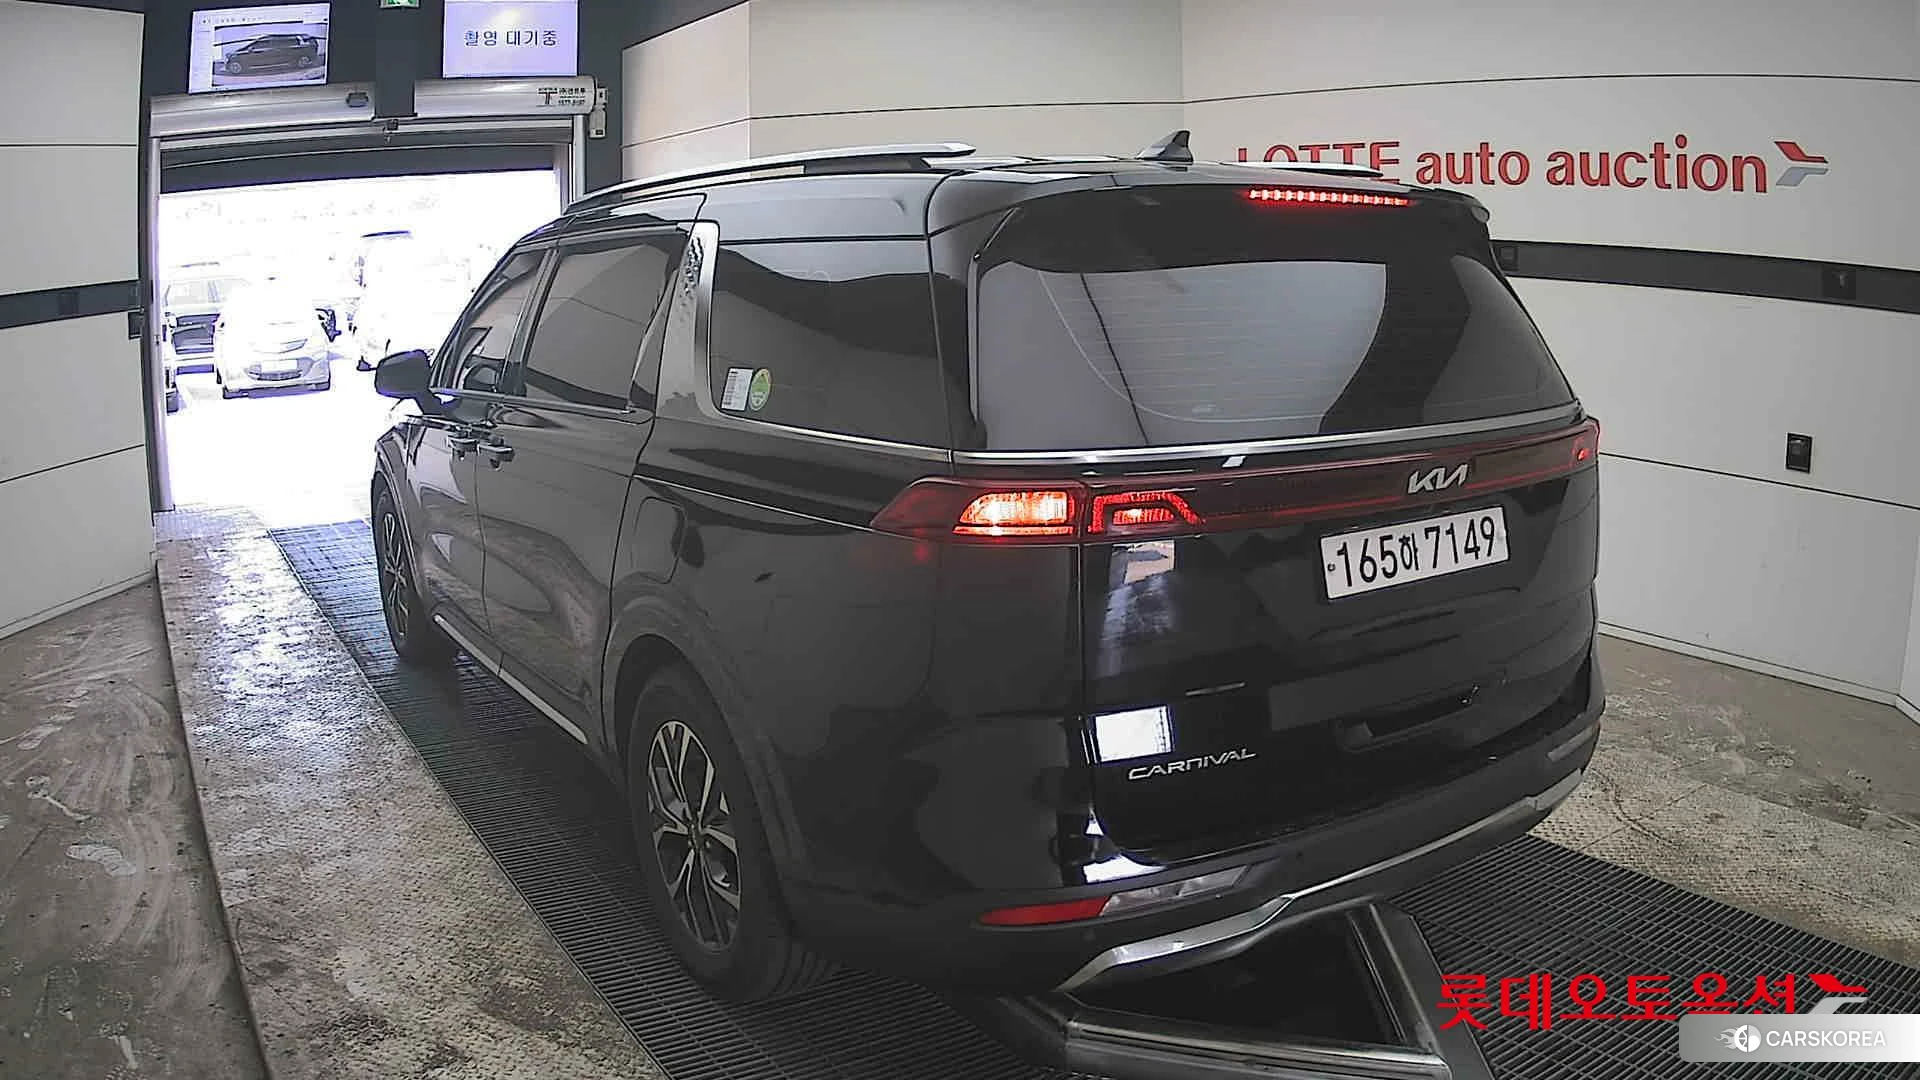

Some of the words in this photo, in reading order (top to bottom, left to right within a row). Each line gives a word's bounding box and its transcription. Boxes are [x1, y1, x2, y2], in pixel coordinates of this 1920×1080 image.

[465, 30, 497, 47] 촬영
[1415, 141, 1529, 186] auto
[1546, 134, 1768, 194] auction
[1407, 463, 1468, 494] KIA
[1128, 748, 1257, 780] CARNIVAL
